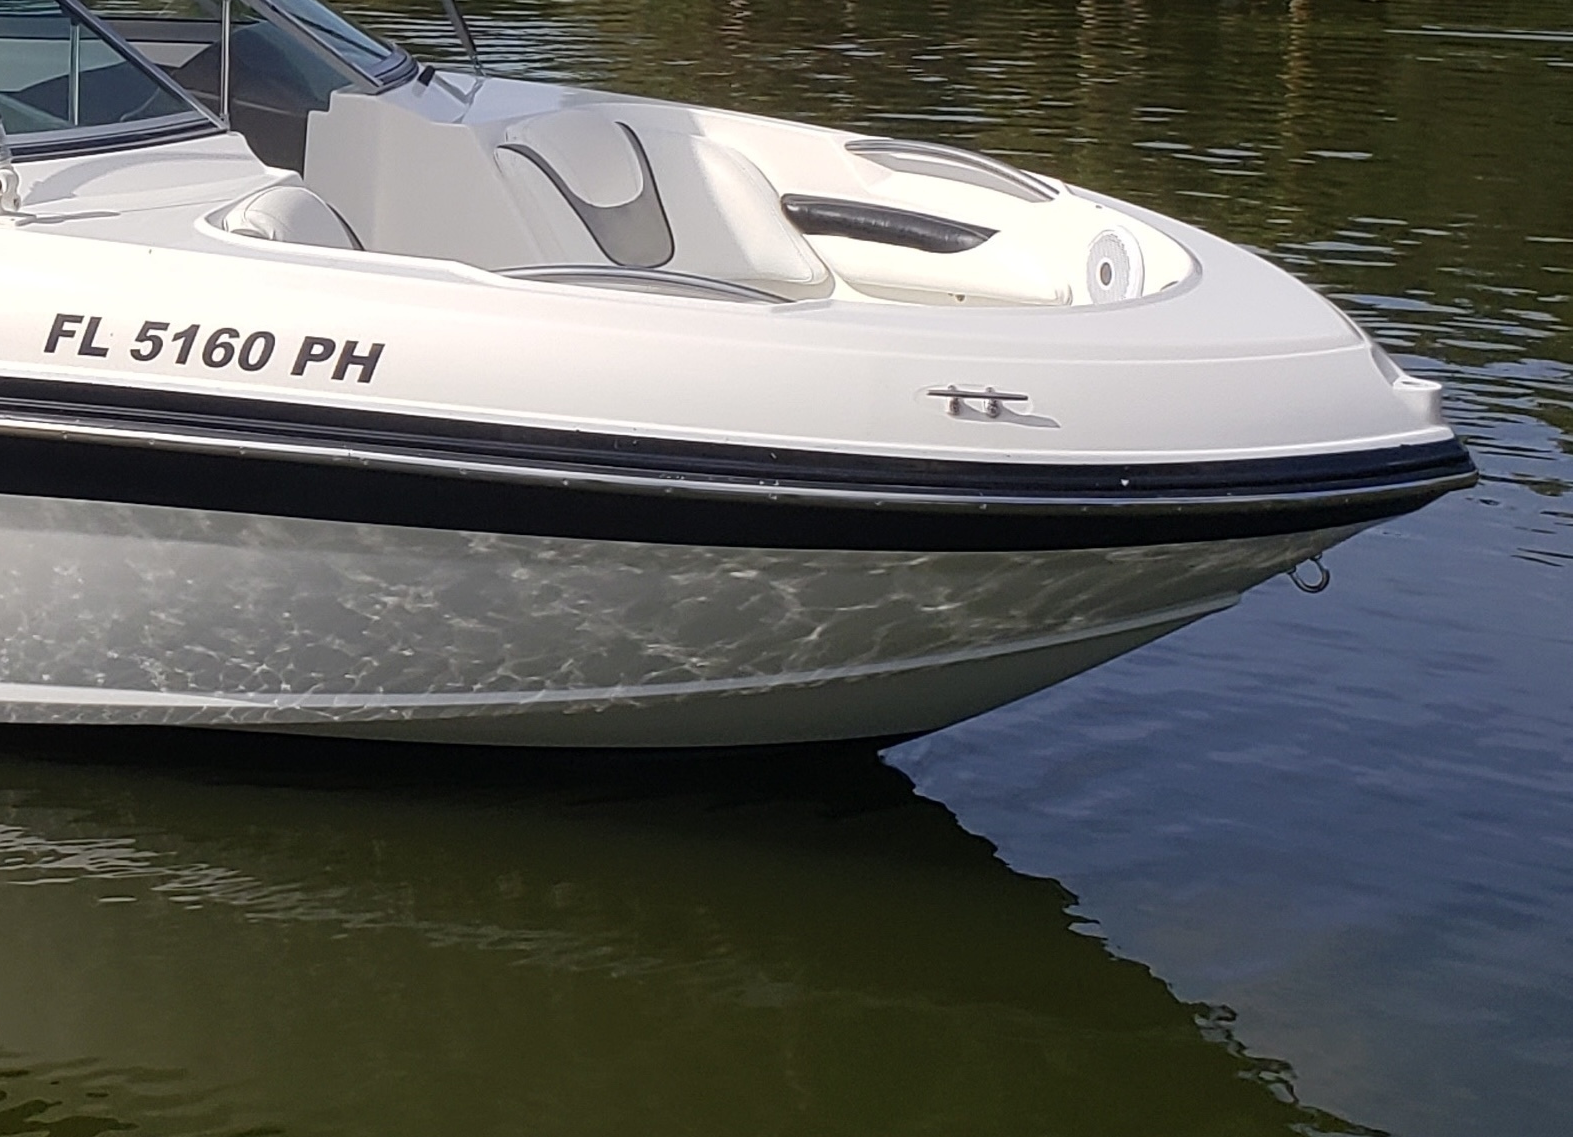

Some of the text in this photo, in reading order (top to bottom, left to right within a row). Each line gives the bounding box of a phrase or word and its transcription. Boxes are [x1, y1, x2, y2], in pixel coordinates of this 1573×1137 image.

[43, 312, 387, 384] FL 5160 PH
